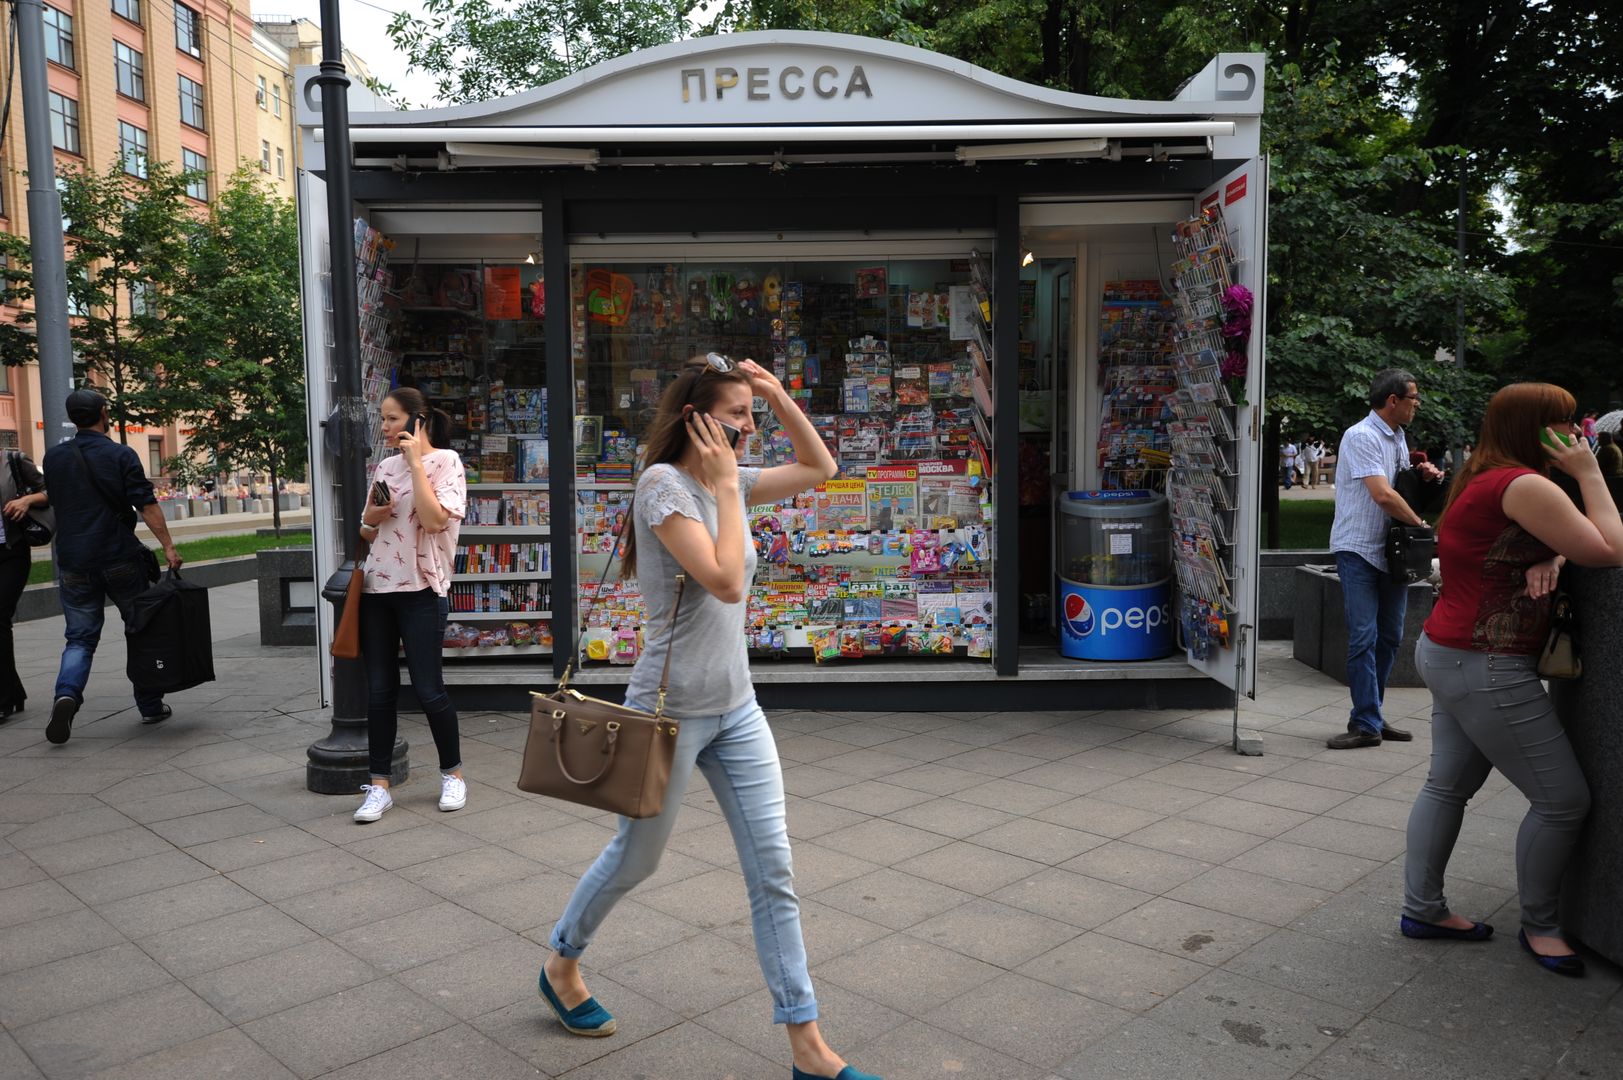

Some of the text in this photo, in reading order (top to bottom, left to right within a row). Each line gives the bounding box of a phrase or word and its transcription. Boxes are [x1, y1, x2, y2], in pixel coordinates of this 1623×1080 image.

[680, 65, 873, 103] ПРЕССА
[918, 465, 955, 474] МОСКВА
[878, 470, 907, 479] ПРОГРАММА
[878, 485, 913, 496] ТЕЛЕК
[1103, 490, 1133, 499] pepsi
[832, 494, 861, 505] ДАЧА
[851, 583, 878, 592] сад
[885, 583, 910, 592] сад
[1101, 605, 1169, 636] peps
